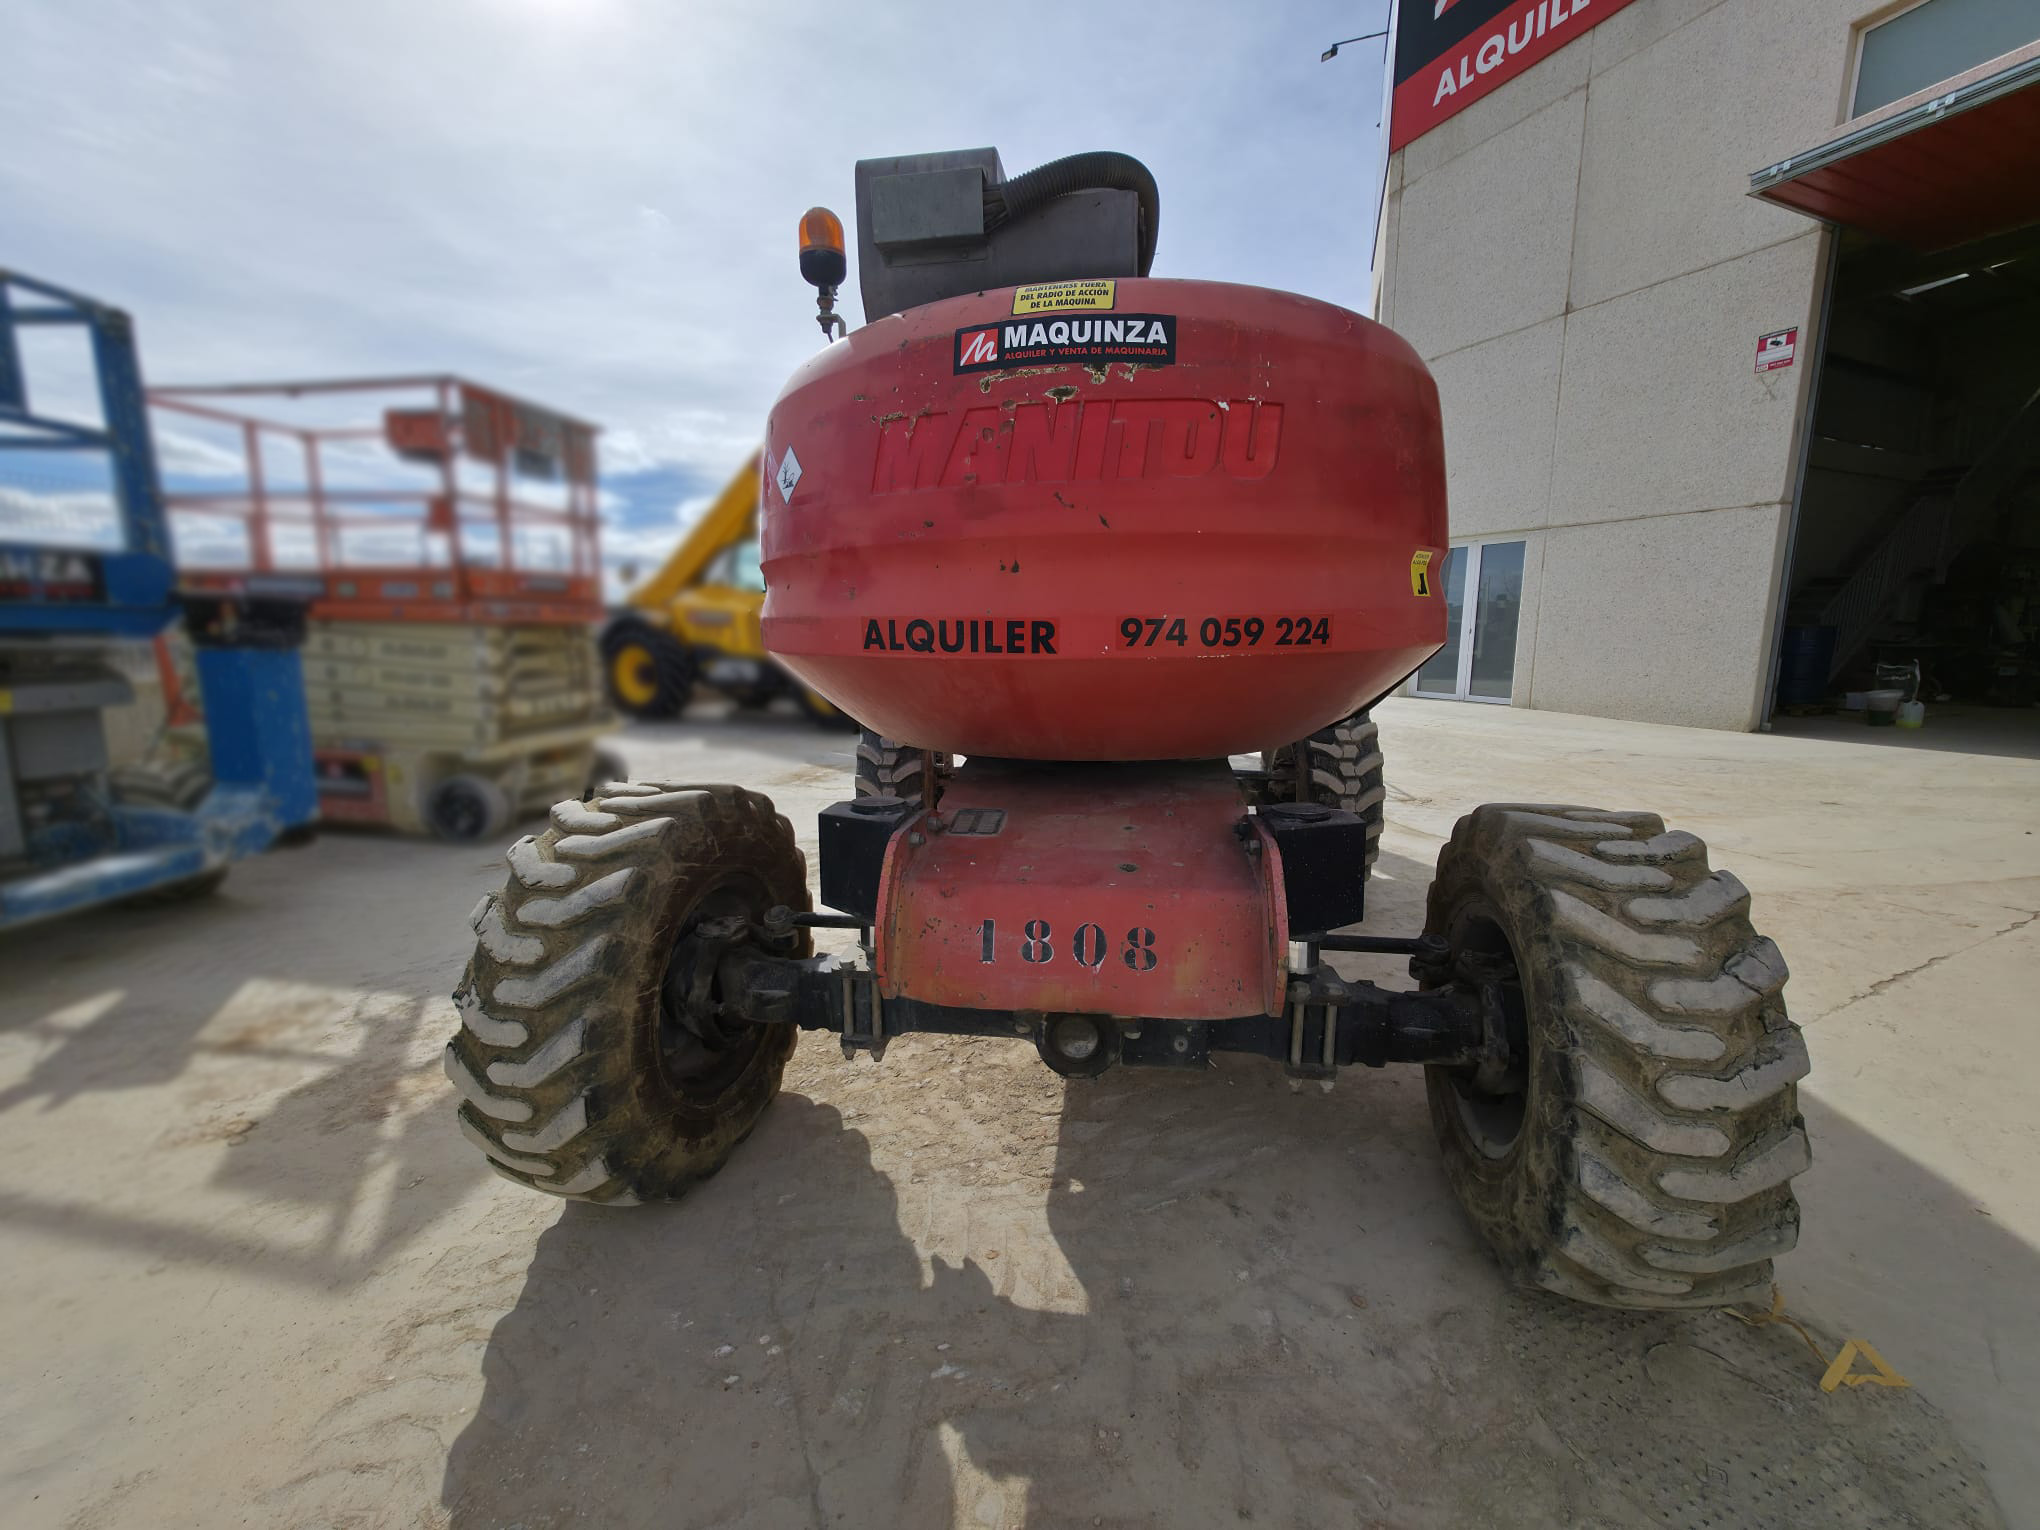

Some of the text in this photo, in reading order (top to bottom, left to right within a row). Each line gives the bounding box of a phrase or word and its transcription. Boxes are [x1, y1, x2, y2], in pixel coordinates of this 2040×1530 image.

[1030, 301, 1040, 309] DE
[1043, 300, 1053, 308] LA
[1037, 290, 1063, 299] RADIO
[1004, 320, 1168, 349] MAQUINZA
[1004, 349, 1047, 360] ALQUILER
[1058, 347, 1088, 355] VENTA
[1090, 347, 1102, 355] DE
[1105, 347, 1168, 356] MAQUINARIA
[871, 397, 1286, 496] MANITOU
[863, 618, 1058, 655] ALQUILER
[1120, 617, 1330, 647] 974 059 224
[976, 919, 1158, 972] 1808
